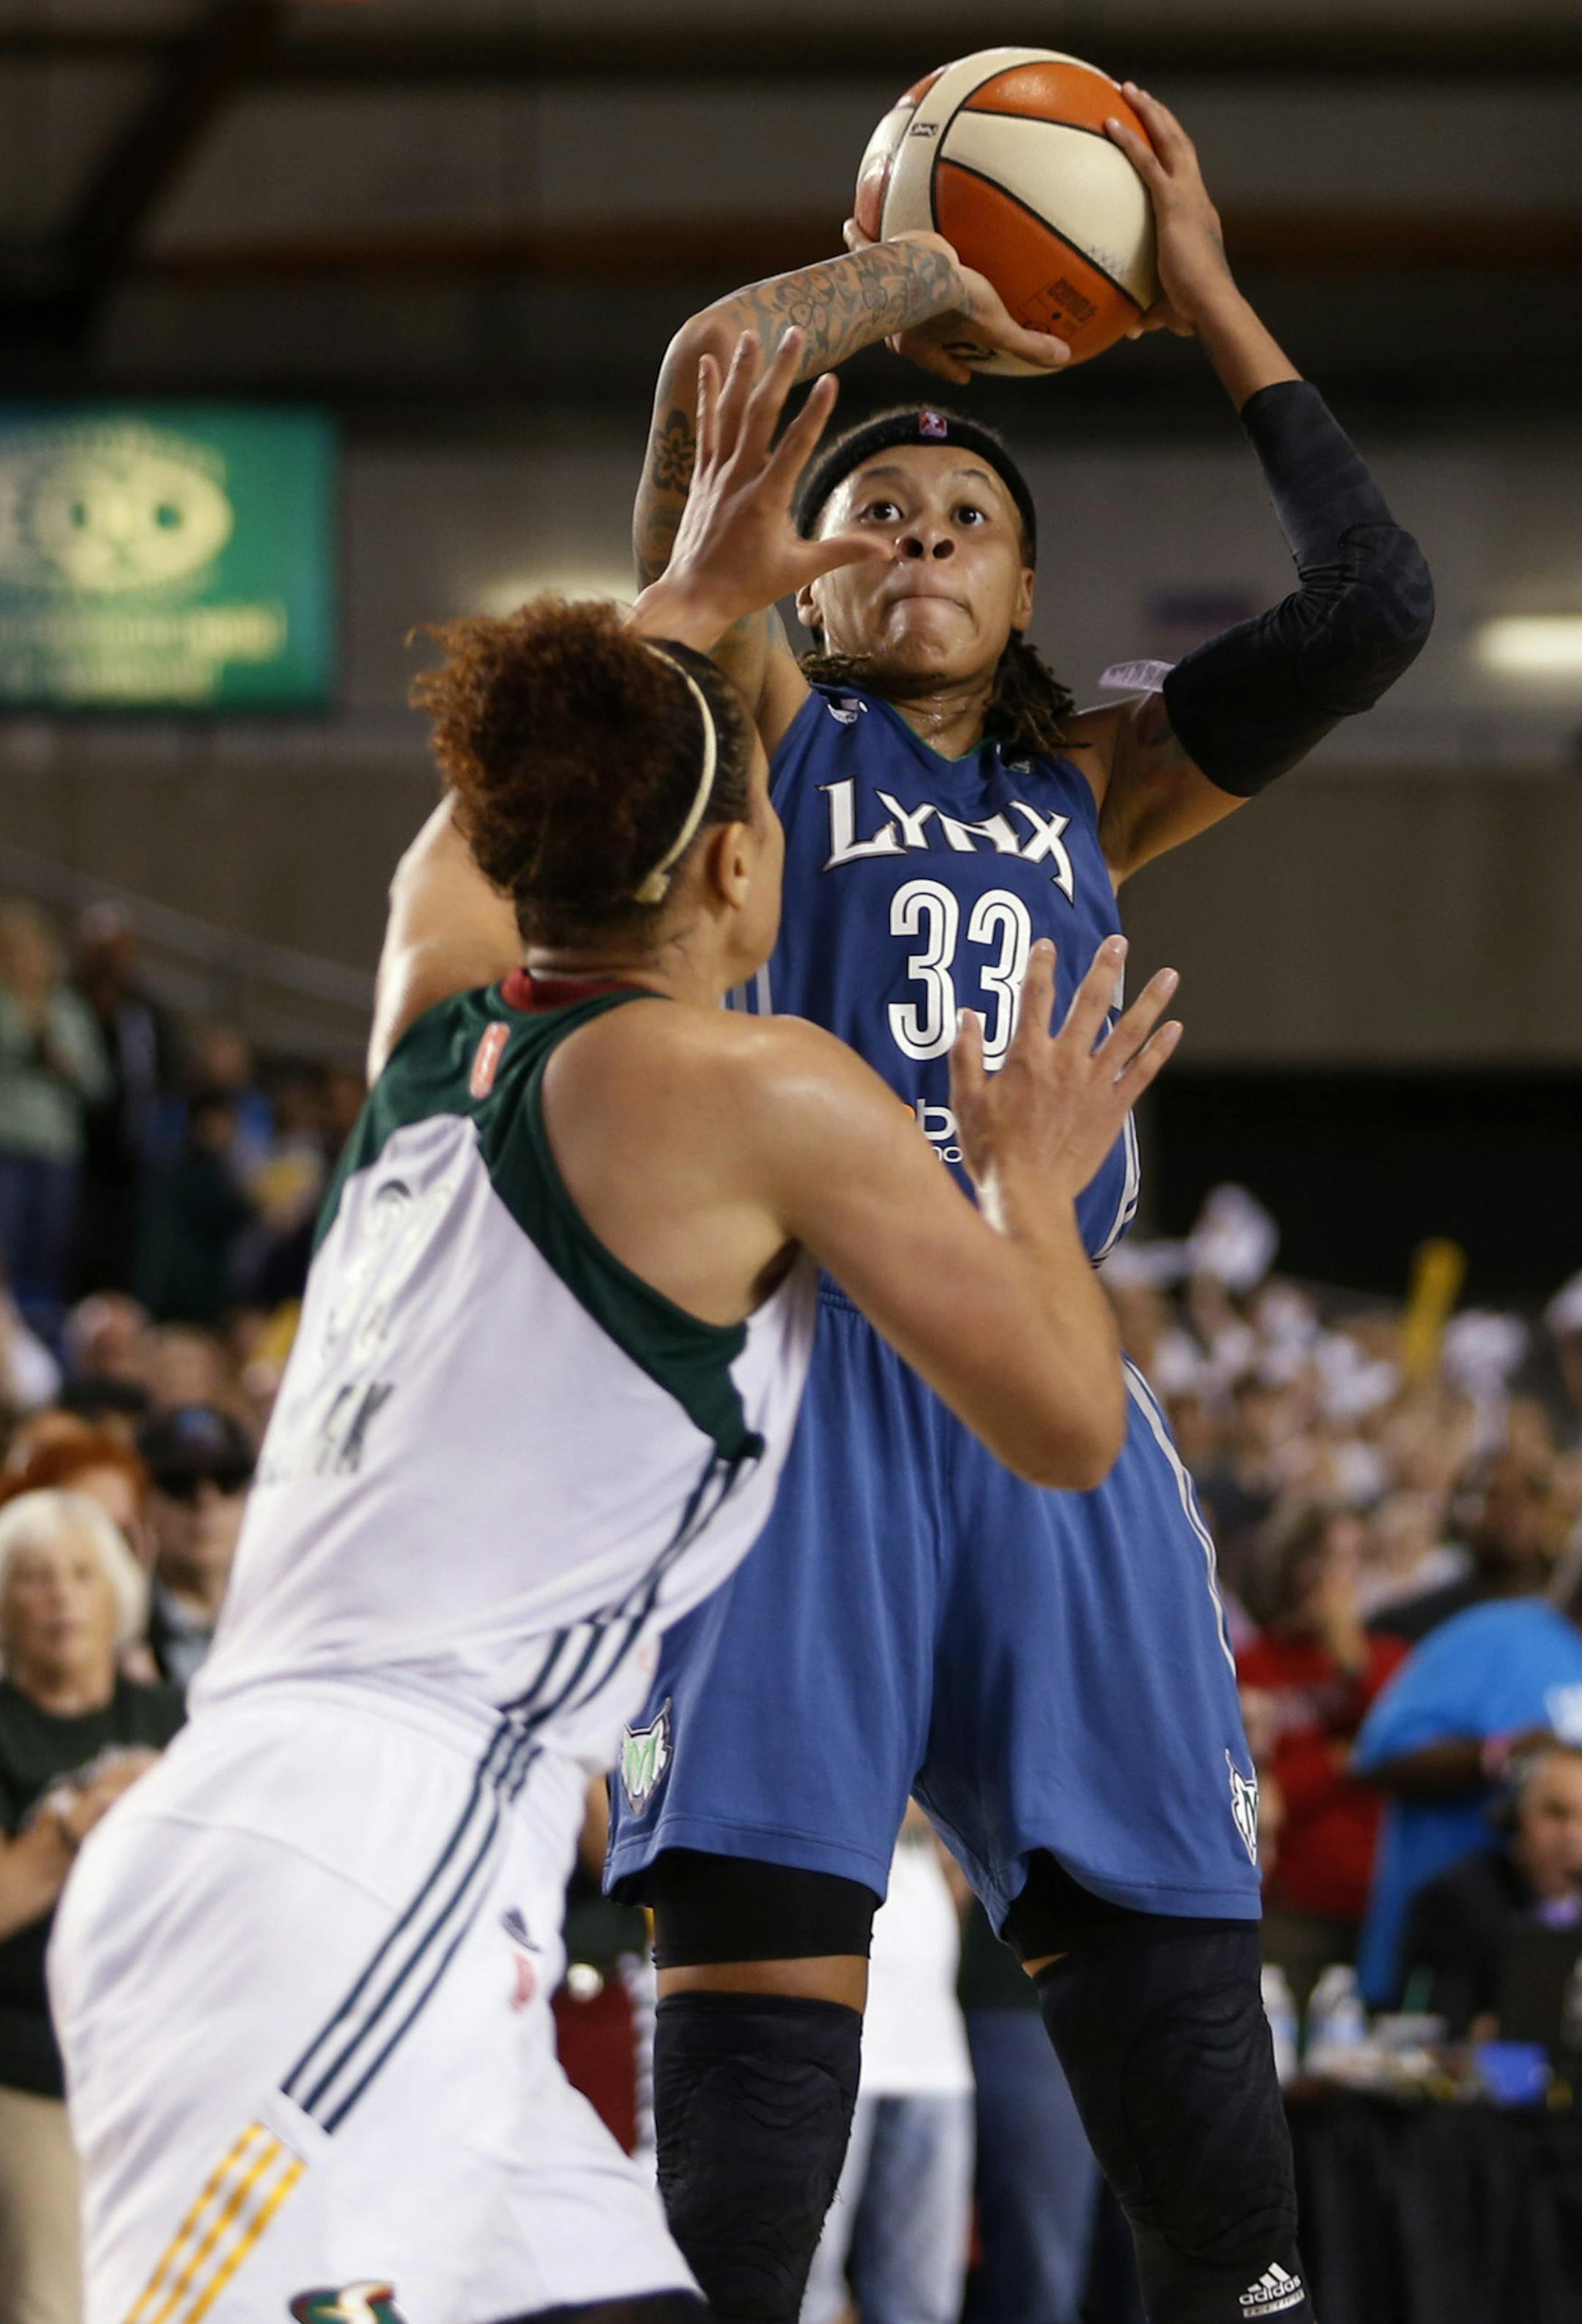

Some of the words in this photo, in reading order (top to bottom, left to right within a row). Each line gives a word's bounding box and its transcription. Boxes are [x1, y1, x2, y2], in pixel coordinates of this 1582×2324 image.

[816, 778, 1074, 905] LYNX
[888, 879, 1032, 1070] 33
[1239, 2275, 1301, 2306] adidas
